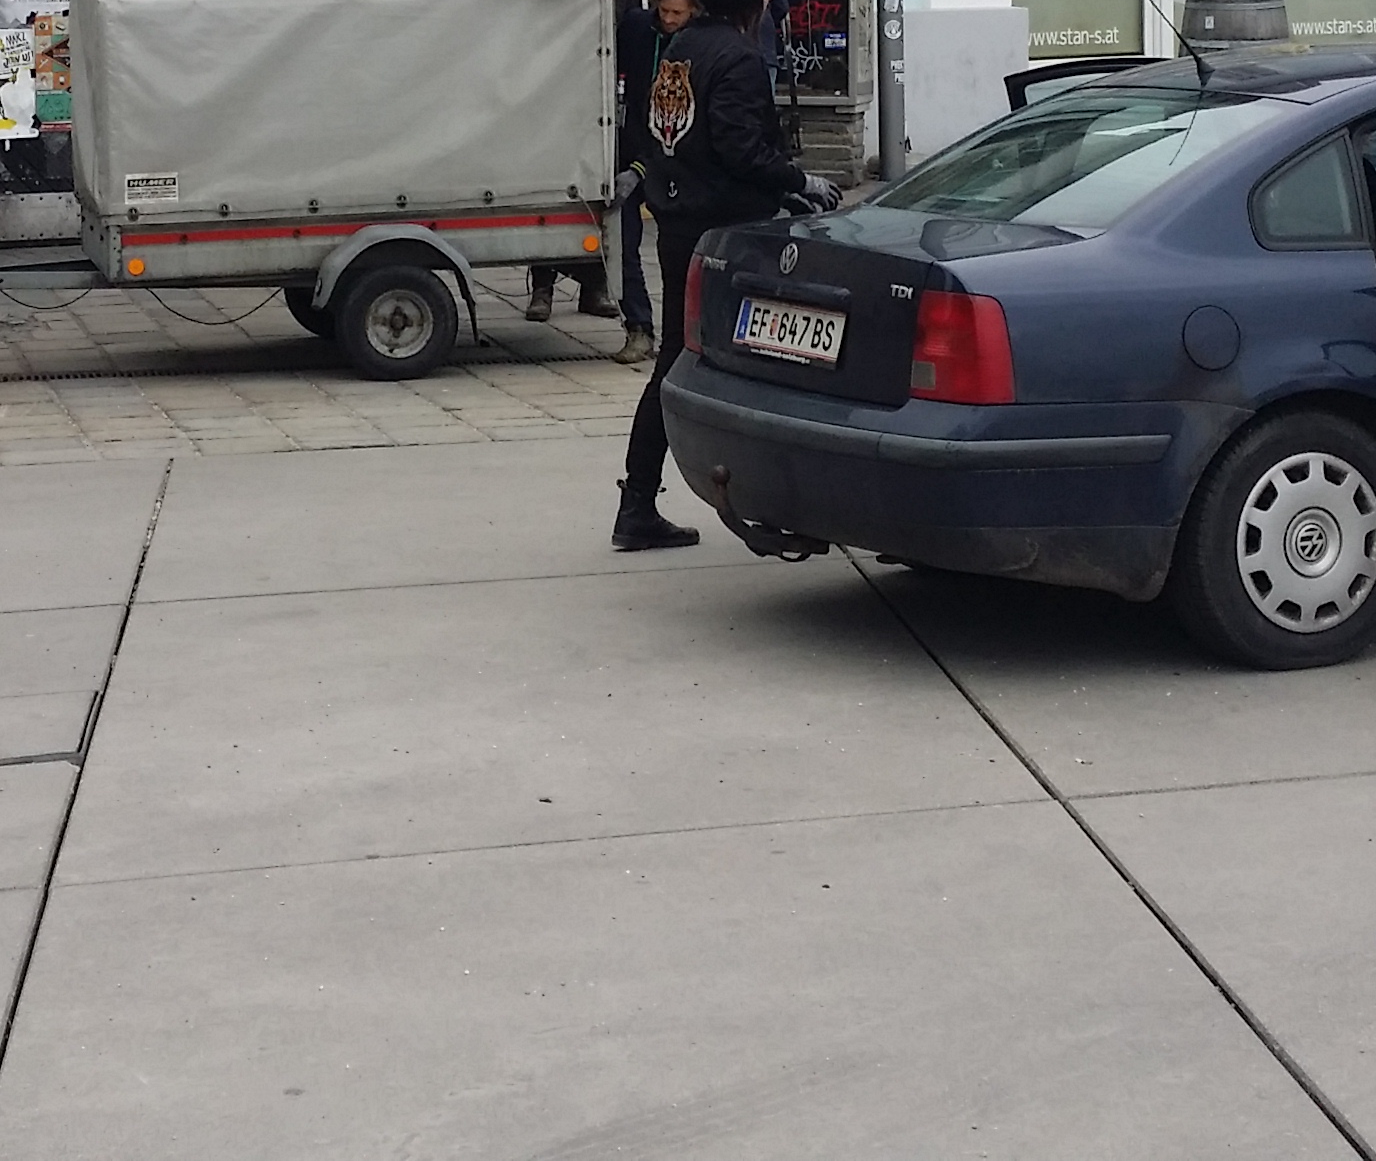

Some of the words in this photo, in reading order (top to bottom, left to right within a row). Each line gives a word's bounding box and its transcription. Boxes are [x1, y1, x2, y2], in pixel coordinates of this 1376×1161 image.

[1028, 26, 1120, 46] ww.stan-s.at
[129, 179, 174, 187] HUMER
[889, 283, 915, 300] TDI
